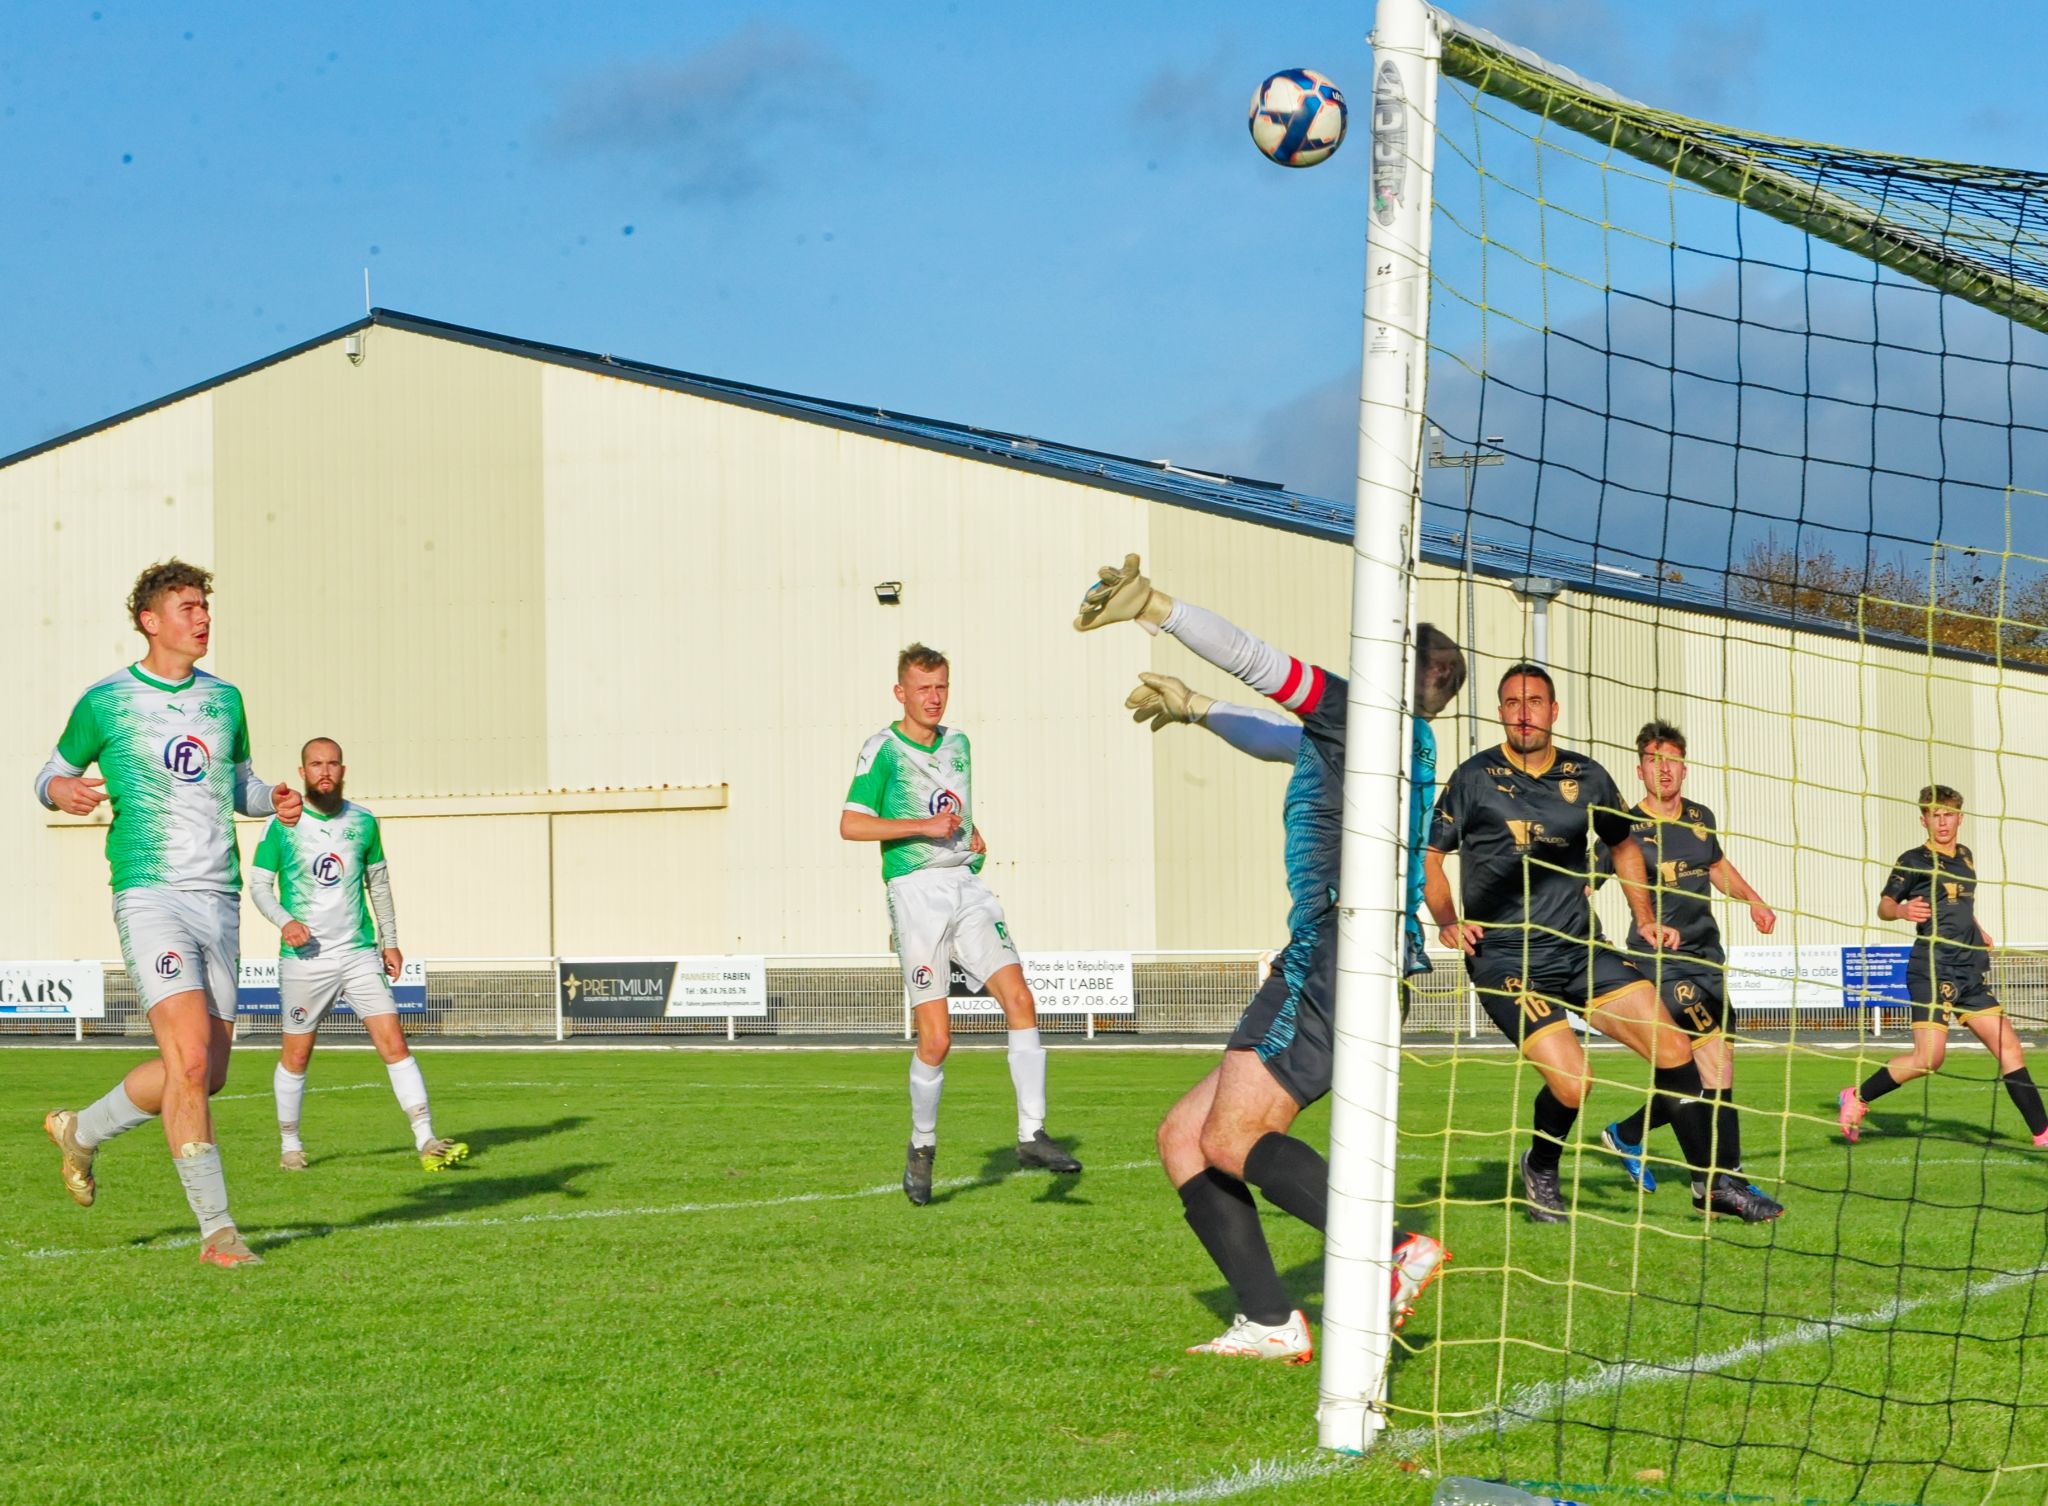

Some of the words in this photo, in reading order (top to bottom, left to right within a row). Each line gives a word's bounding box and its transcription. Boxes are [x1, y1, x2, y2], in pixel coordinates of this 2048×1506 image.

[1028, 960, 1050, 971] Place
[1053, 960, 1064, 971] de
[1067, 960, 1075, 971] la
[1077, 959, 1125, 973] République
[1812, 966, 1839, 977] côte
[723, 972, 751, 981] FABIEN
[1514, 995, 1551, 1022] 16
